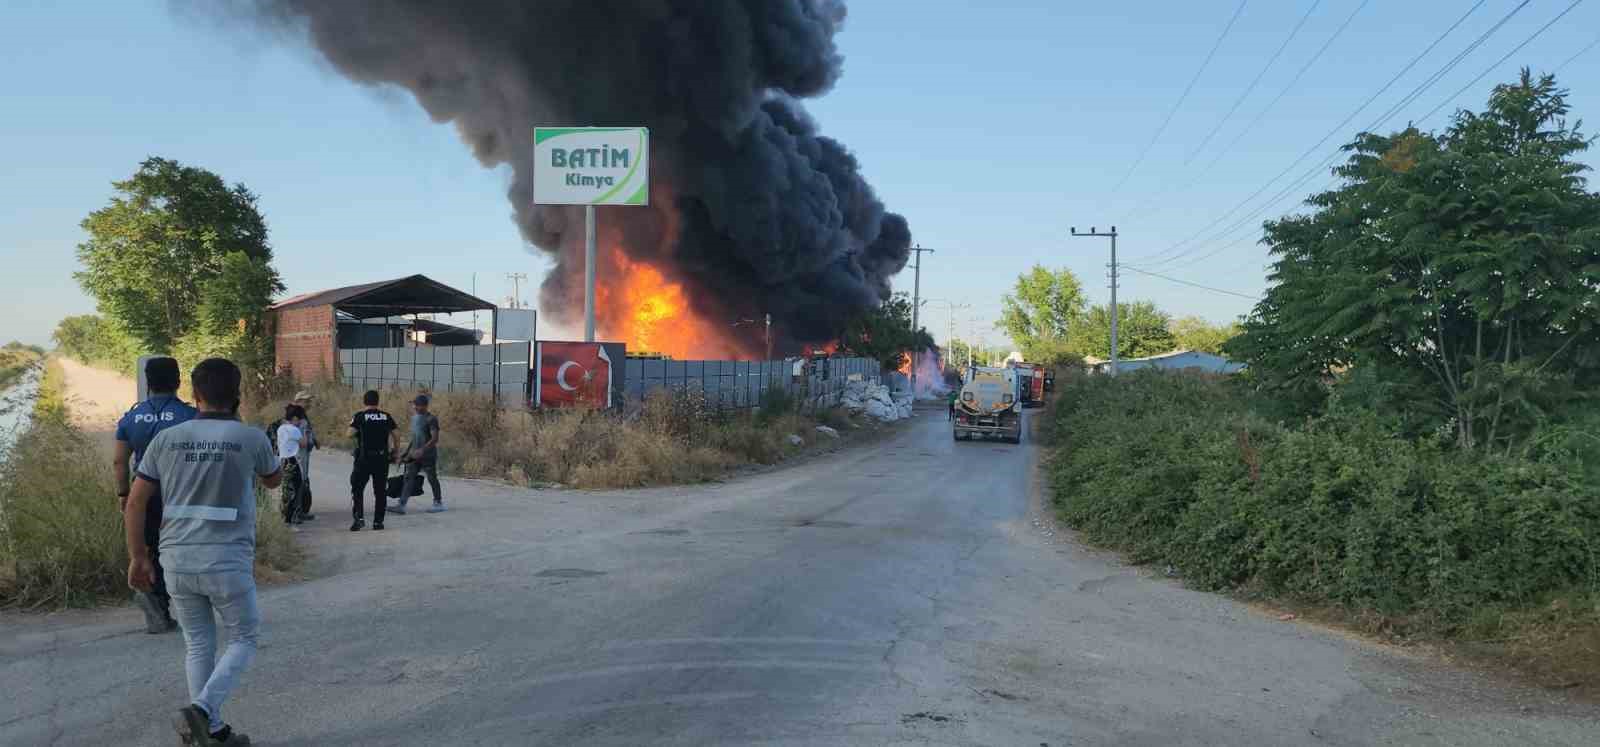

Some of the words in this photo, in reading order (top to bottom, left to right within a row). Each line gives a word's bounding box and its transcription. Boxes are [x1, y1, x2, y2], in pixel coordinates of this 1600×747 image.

[552, 144, 629, 169] BATİM
[565, 173, 614, 188] Kimya
[169, 440, 196, 453] RSA
[185, 453, 225, 462] BELEDES
